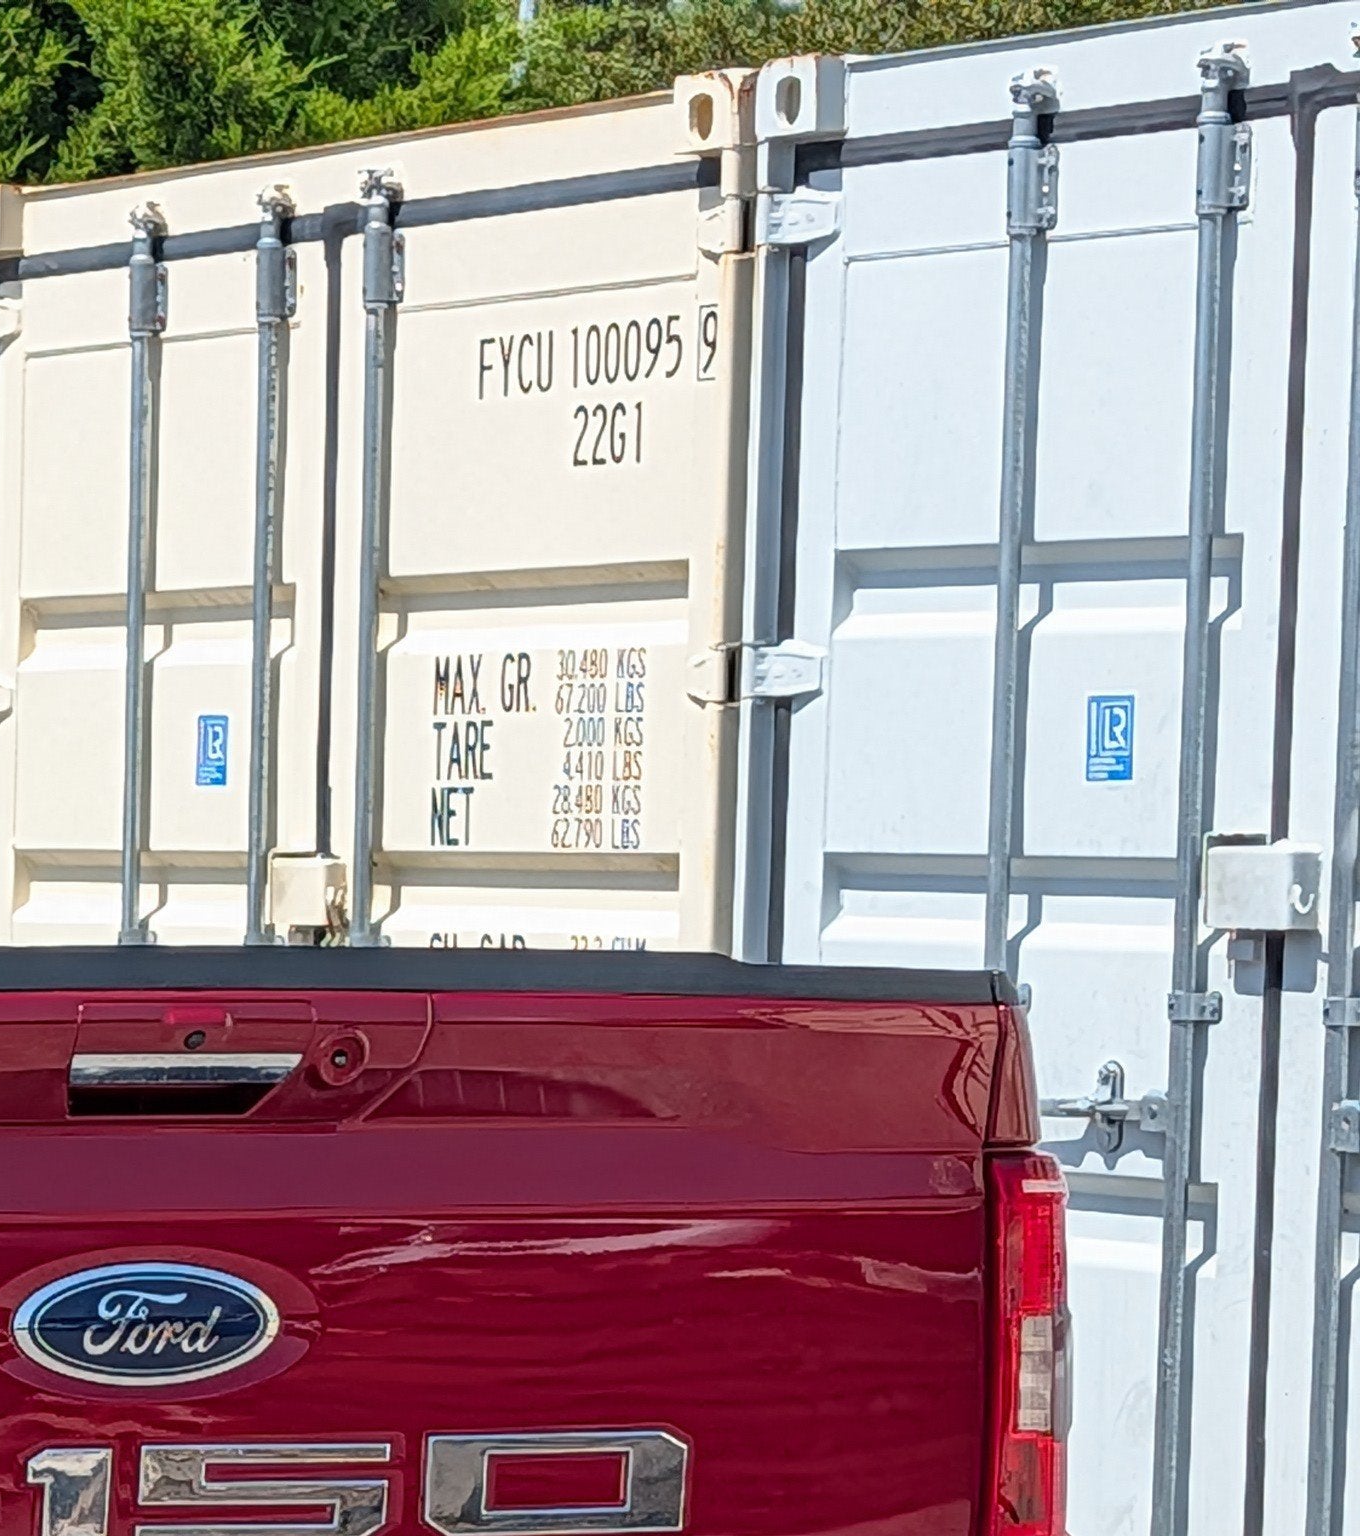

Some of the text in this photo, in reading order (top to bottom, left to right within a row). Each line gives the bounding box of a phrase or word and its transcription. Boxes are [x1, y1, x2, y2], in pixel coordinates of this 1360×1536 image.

[479, 311, 718, 400] FYCU 100095 9
[572, 401, 643, 467] 22G1
[432, 654, 486, 716] MAX.
[500, 652, 537, 713] GR.
[616, 647, 647, 678] KGS
[615, 681, 645, 713] LBS
[432, 719, 494, 780] TARE
[614, 716, 643, 747] KGS
[612, 750, 642, 781] LBS
[430, 787, 475, 847] NET
[611, 784, 642, 815] KGS
[611, 817, 641, 850] LBS
[83, 1290, 222, 1355] Ford
